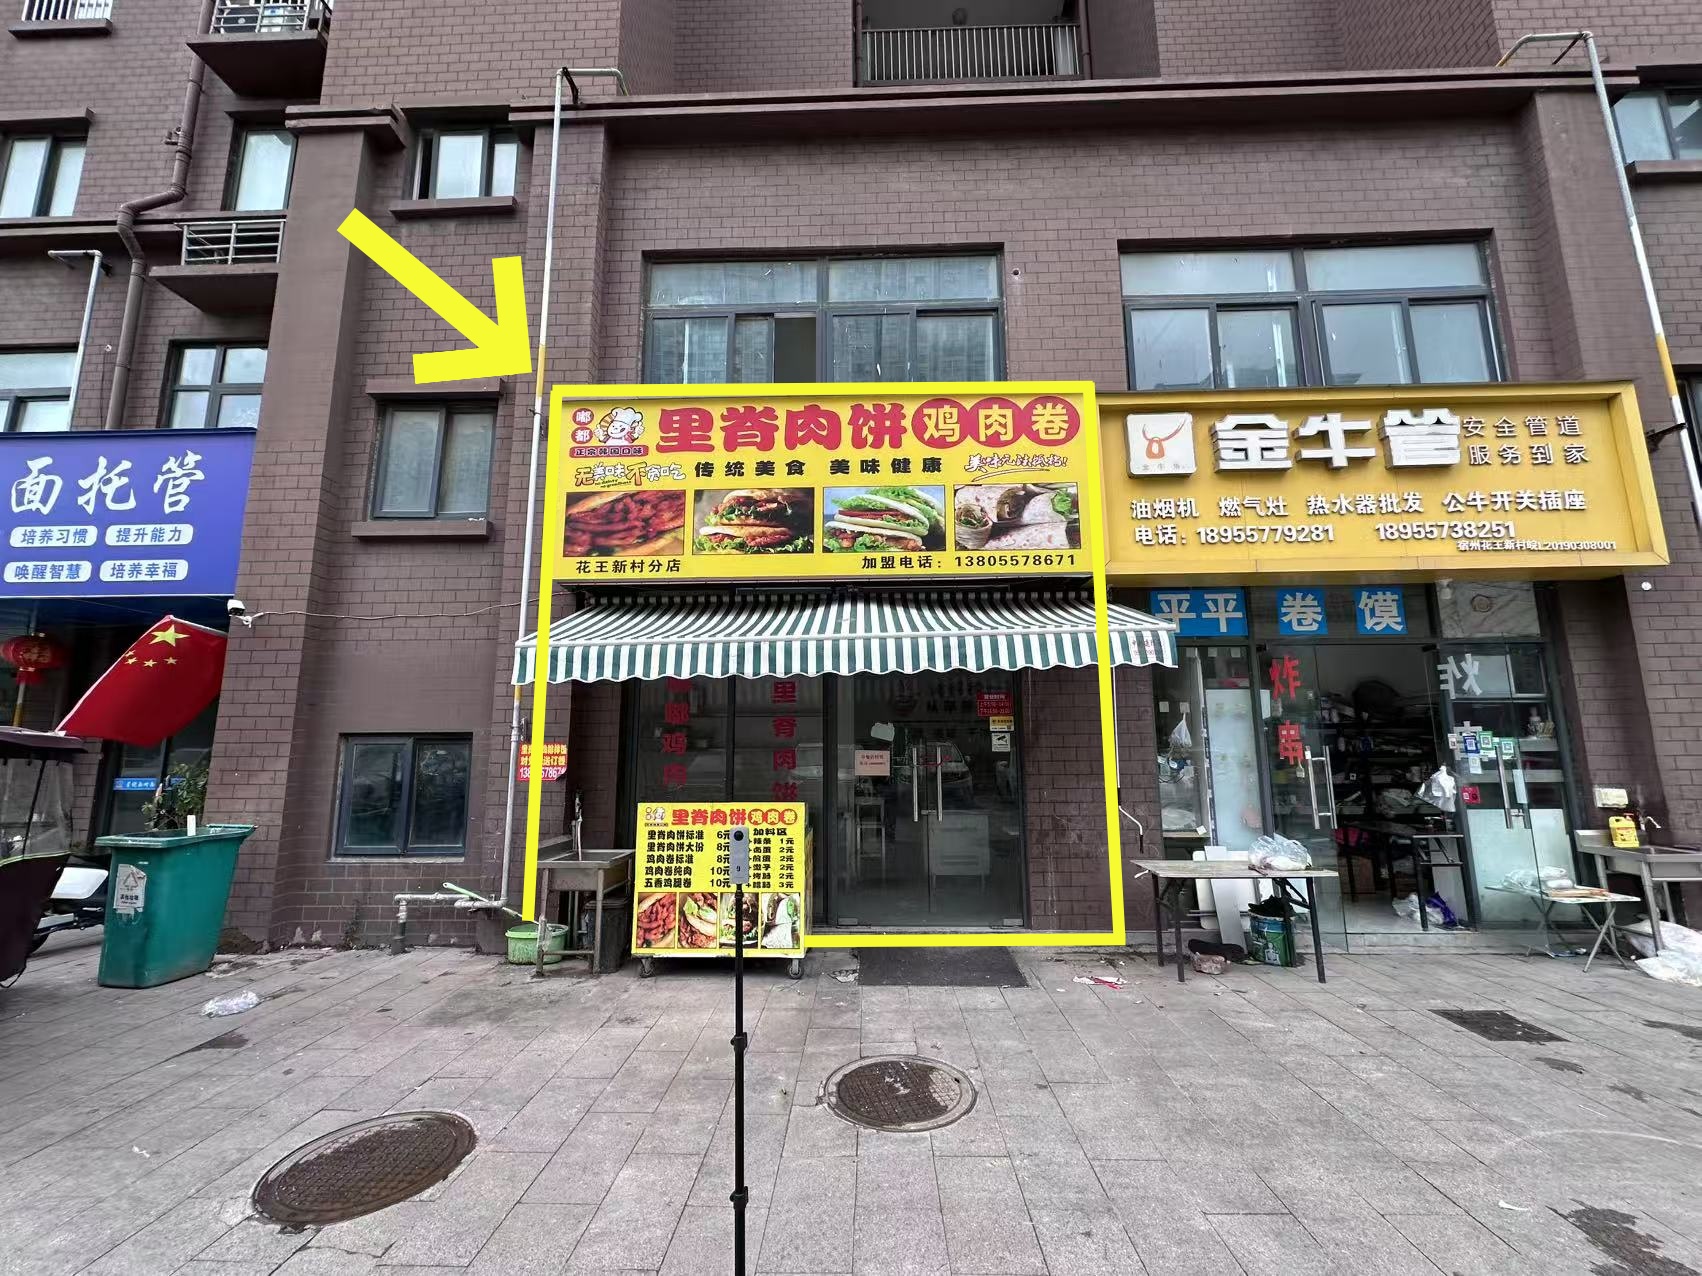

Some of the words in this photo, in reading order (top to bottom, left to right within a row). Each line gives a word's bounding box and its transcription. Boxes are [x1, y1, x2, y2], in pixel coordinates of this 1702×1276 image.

[655, 403, 907, 454] 里脊肉饼
[922, 402, 1069, 443] 鸡肉卷
[1463, 416, 1583, 438] 安全管道
[1211, 408, 1461, 473] 金牛管
[1469, 443, 1589, 465] 服务到家
[694, 460, 806, 477] 传统美食
[830, 457, 942, 475] 美味健康
[11, 450, 206, 515] 面托管
[1131, 497, 1200, 519] 油烟机
[1219, 496, 1288, 518] 燃气灶
[1307, 491, 1424, 515] 热水器批发
[1442, 489, 1587, 513] 公牛开关插座
[21, 528, 89, 545] 培养习惯
[115, 527, 182, 543] 提升能力
[1375, 520, 1516, 541] 18955738251
[14, 563, 82, 580] 唤醒智慧
[110, 562, 178, 578] 培养幸福
[576, 559, 681, 574] 花王新村分店
[671, 809, 746, 825] 里脊肉饼
[751, 811, 796, 824] 鸡肉卷
[648, 830, 704, 840] 里脊肉饼标准
[717, 830, 731, 840] 6元
[753, 828, 787, 836] 加料区
[647, 842, 704, 852] 里脊肉饼大份
[717, 842, 731, 852] 8元
[646, 854, 694, 864] 鸡肉卷标准
[717, 854, 731, 864] 8元
[710, 867, 731, 876] 10元
[710, 878, 731, 888] 10元
